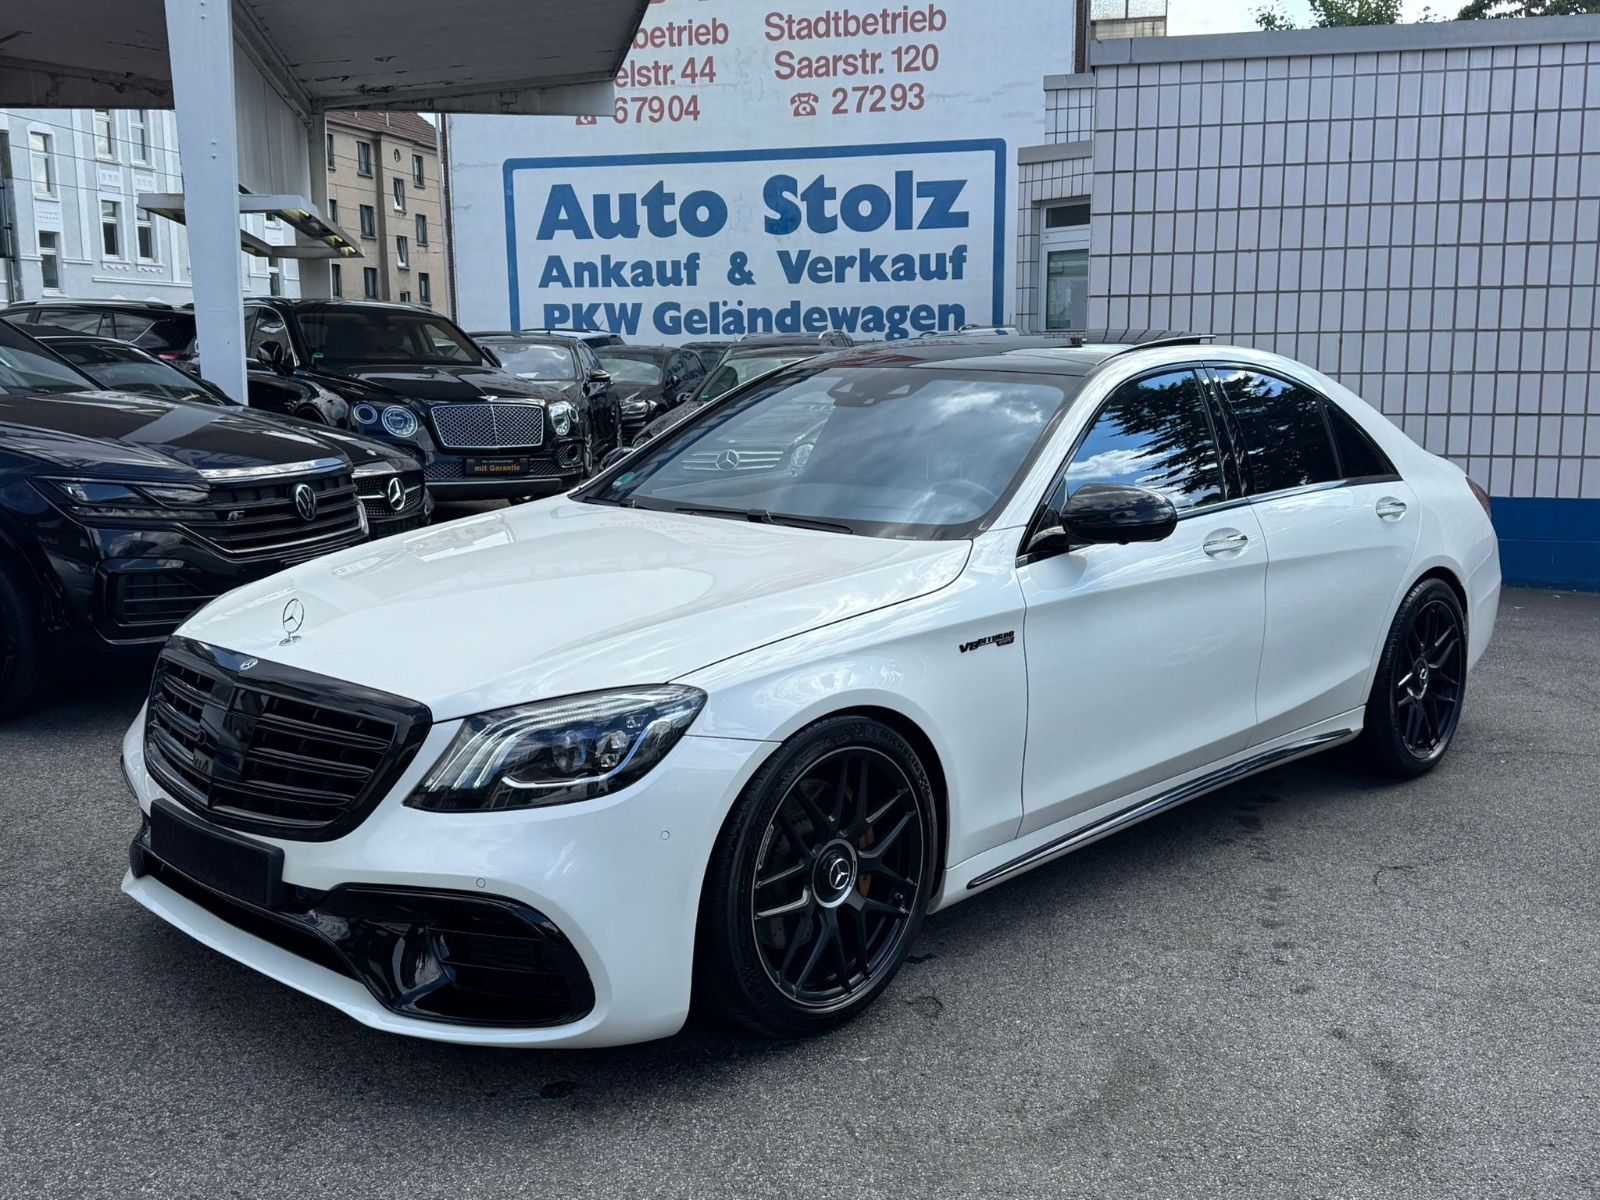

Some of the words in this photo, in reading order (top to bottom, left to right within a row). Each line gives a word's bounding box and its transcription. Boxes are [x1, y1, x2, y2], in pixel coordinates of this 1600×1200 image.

[764, 3, 947, 42] Stadtbetrieb
[680, 55, 717, 84] 44
[774, 48, 884, 81] Saarstr.
[891, 43, 939, 73] 120
[536, 179, 729, 241] Auto
[762, 169, 970, 236] Stolz
[538, 252, 701, 289] Ankauf
[726, 250, 757, 286] &
[776, 244, 968, 285] Verkauf
[543, 302, 644, 336] PKW
[652, 299, 966, 342] Geländewagen
[489, 464, 521, 472] Garantie
